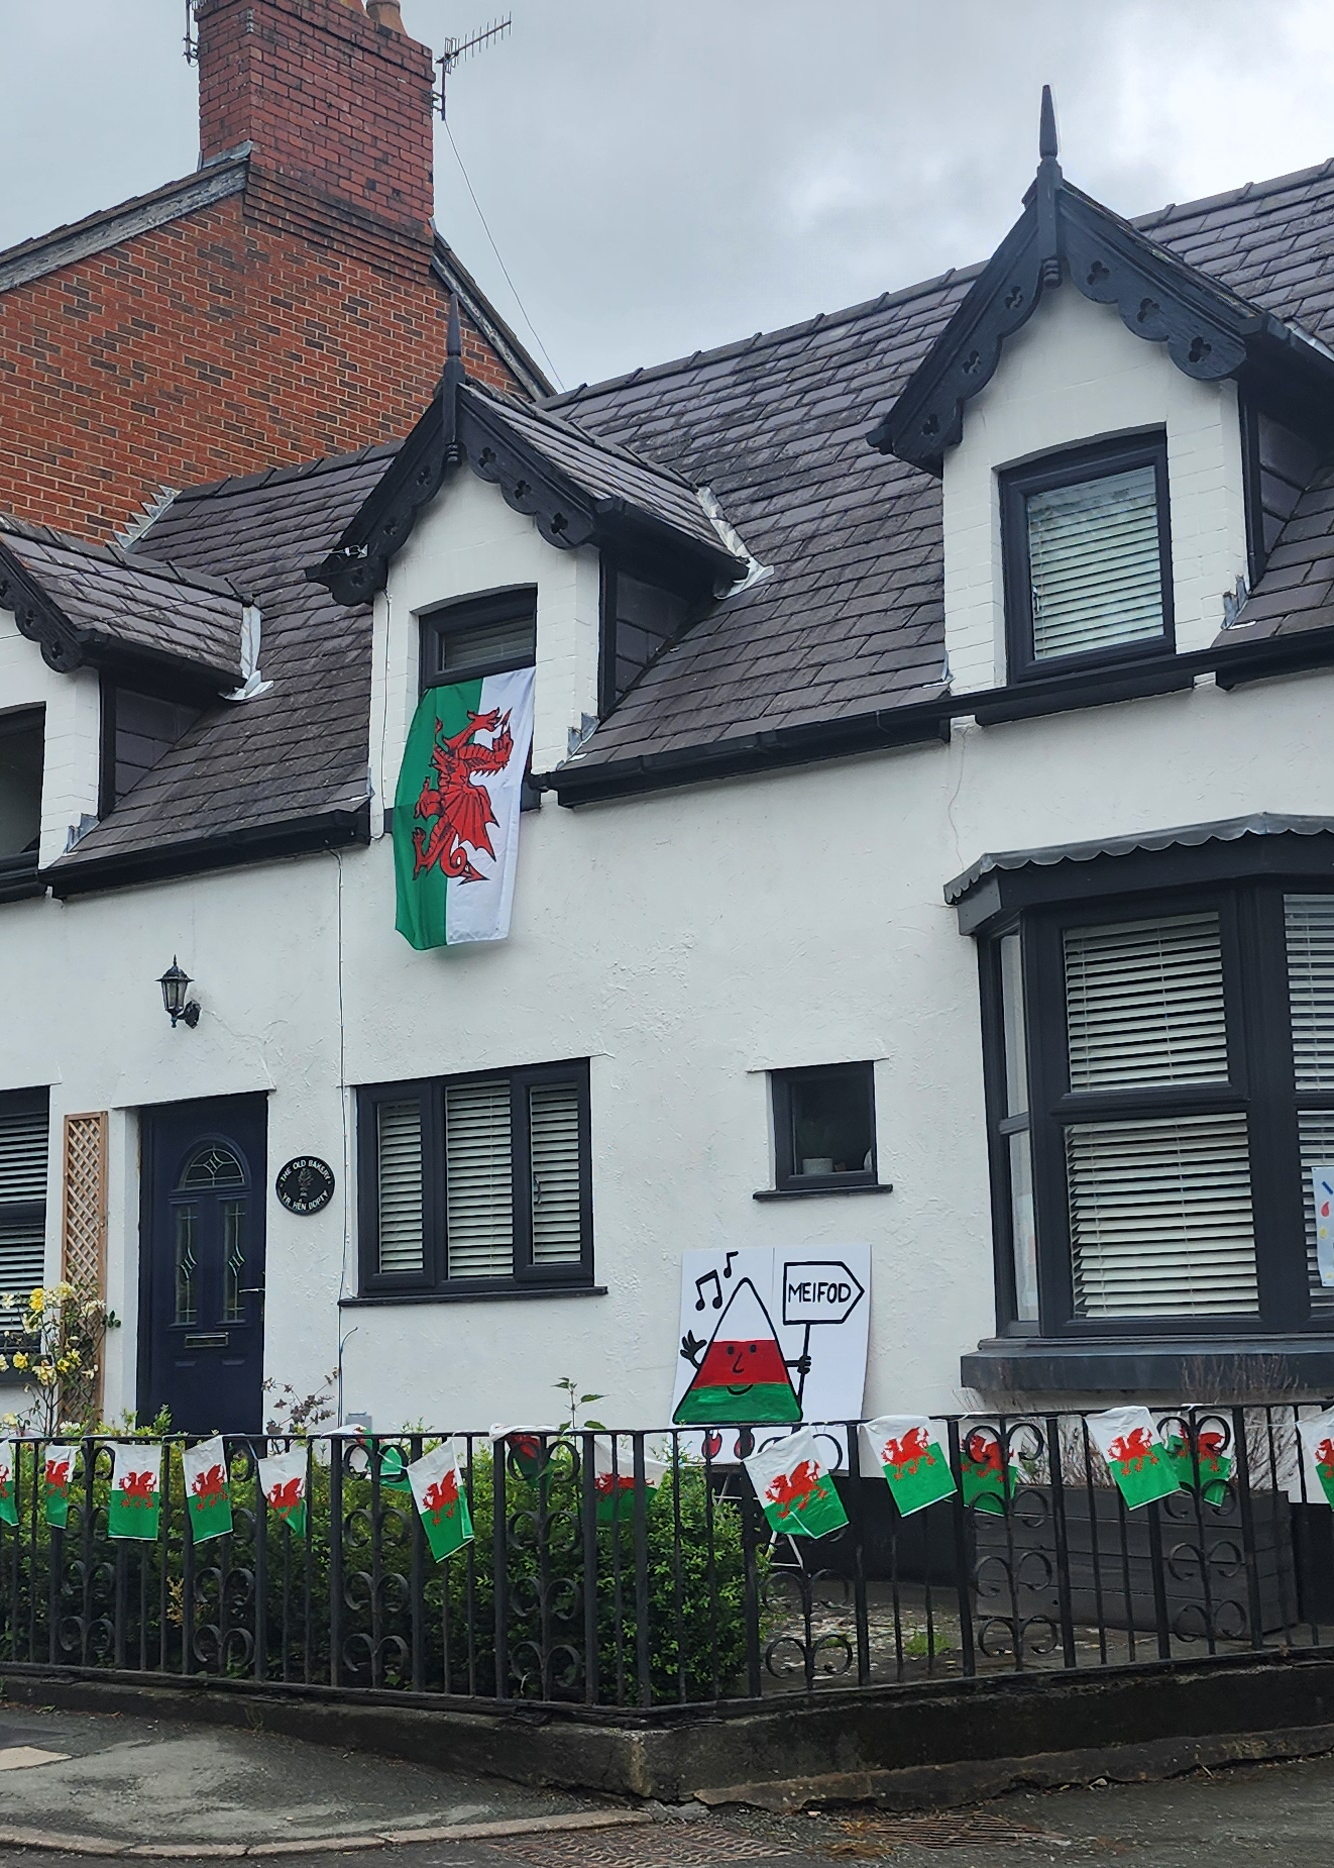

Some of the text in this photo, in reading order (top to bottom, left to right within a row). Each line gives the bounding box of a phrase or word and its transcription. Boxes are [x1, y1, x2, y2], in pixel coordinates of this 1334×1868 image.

[280, 1160, 331, 1182] THE OLD BAKERY
[281, 1193, 292, 1204] YR
[292, 1202, 307, 1211] HEN
[788, 1282, 852, 1304] MEIFOD
